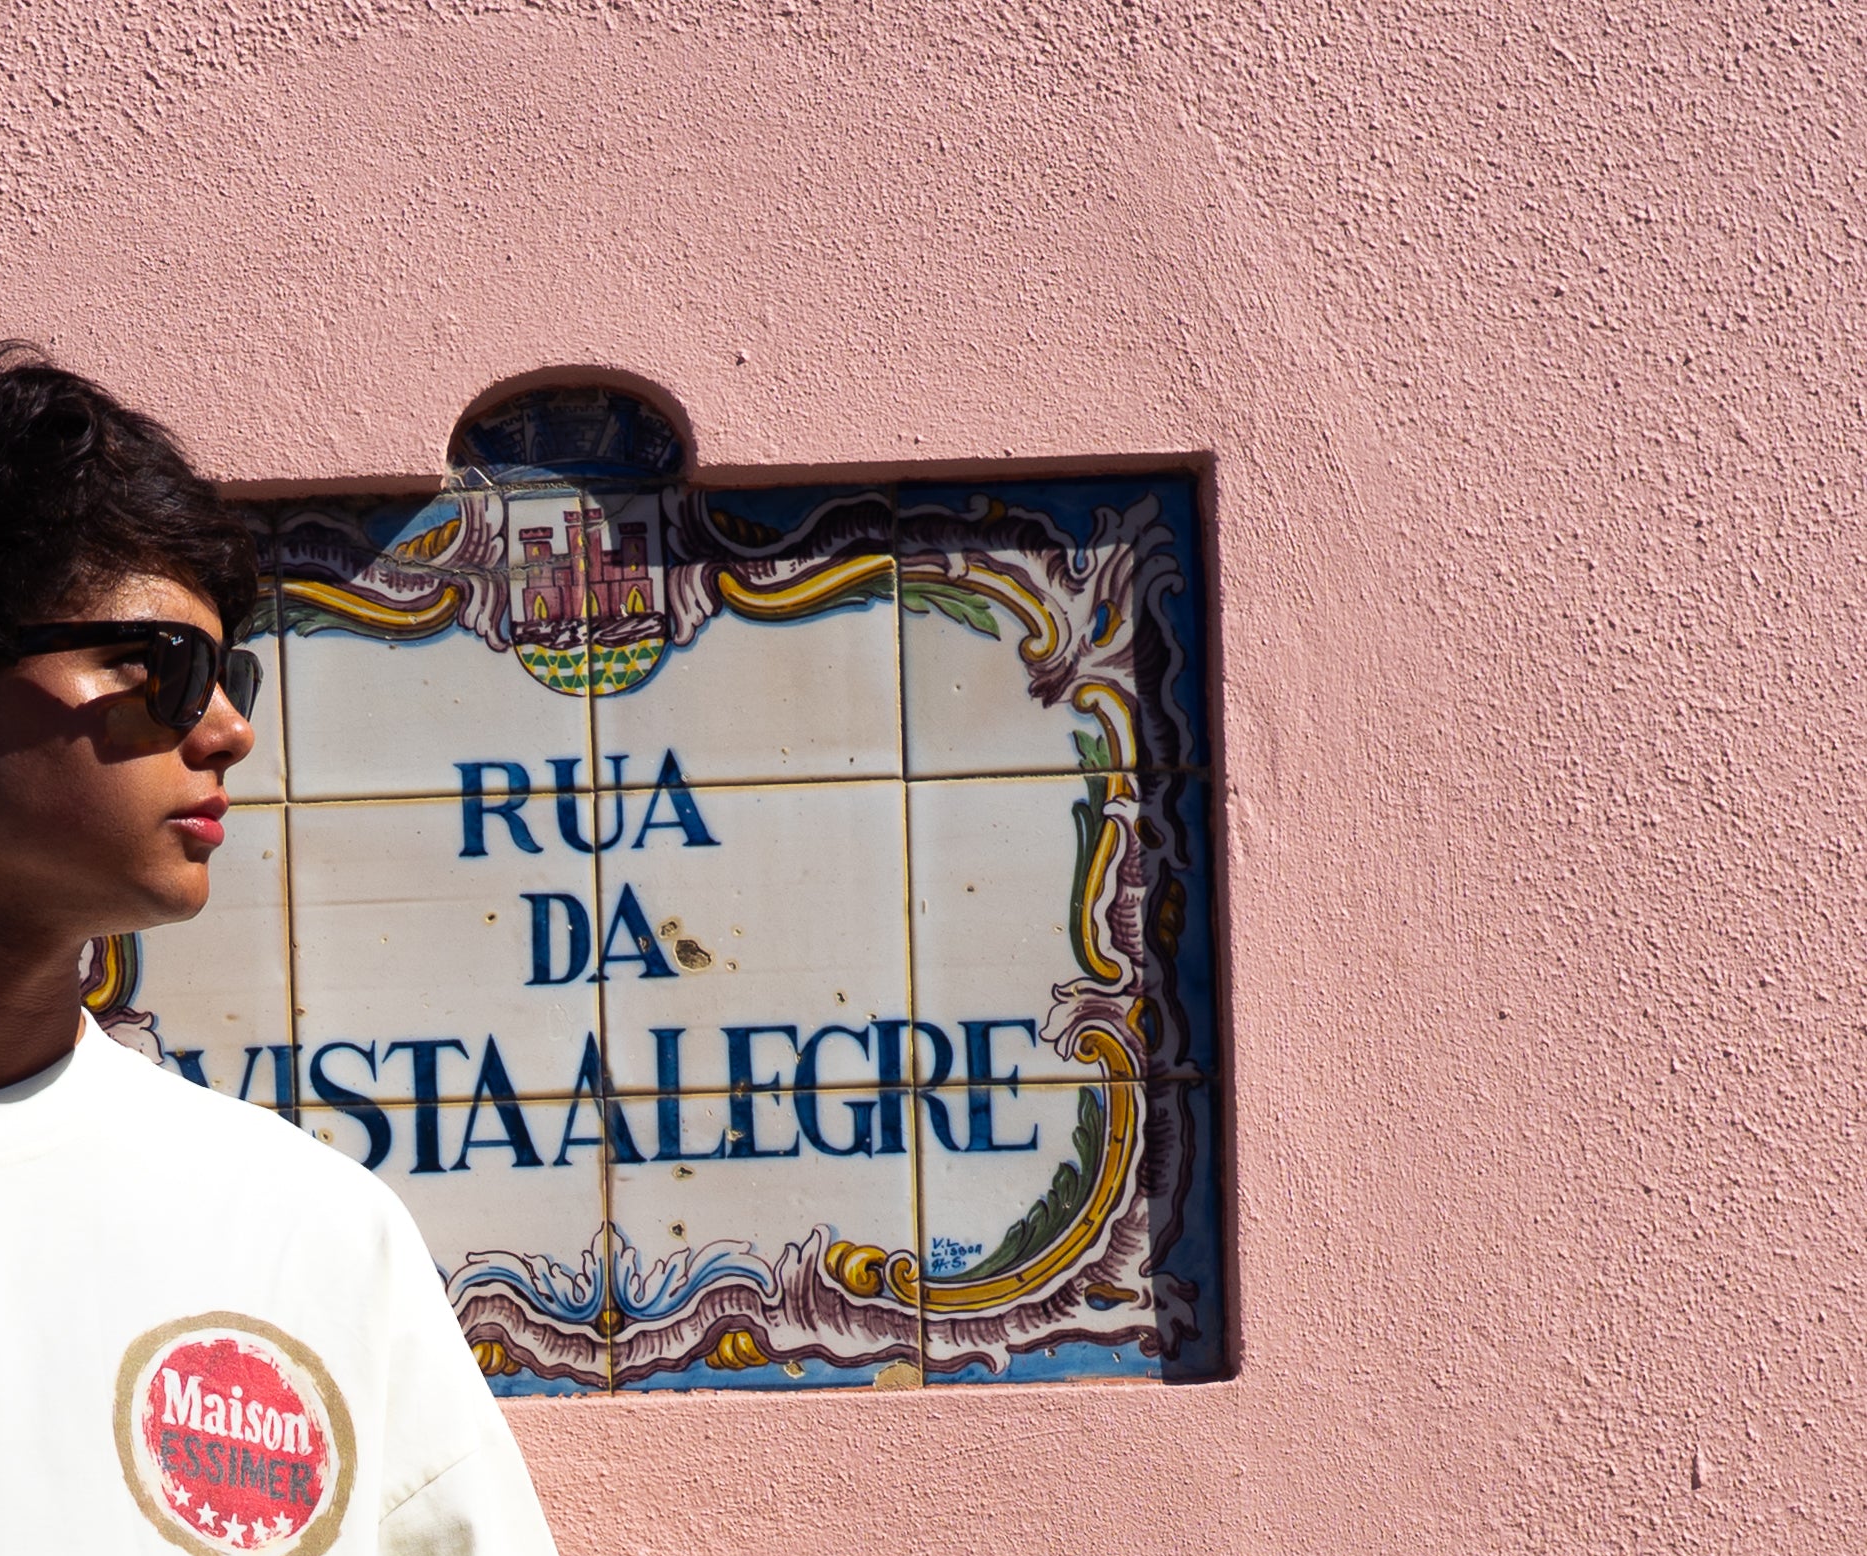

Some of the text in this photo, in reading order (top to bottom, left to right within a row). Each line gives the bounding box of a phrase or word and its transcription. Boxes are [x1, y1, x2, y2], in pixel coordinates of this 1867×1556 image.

[452, 747, 722, 858] RUA
[518, 882, 680, 986] DA
[160, 1366, 313, 1457] Maison
[158, 1428, 316, 1507] ESSIMER
